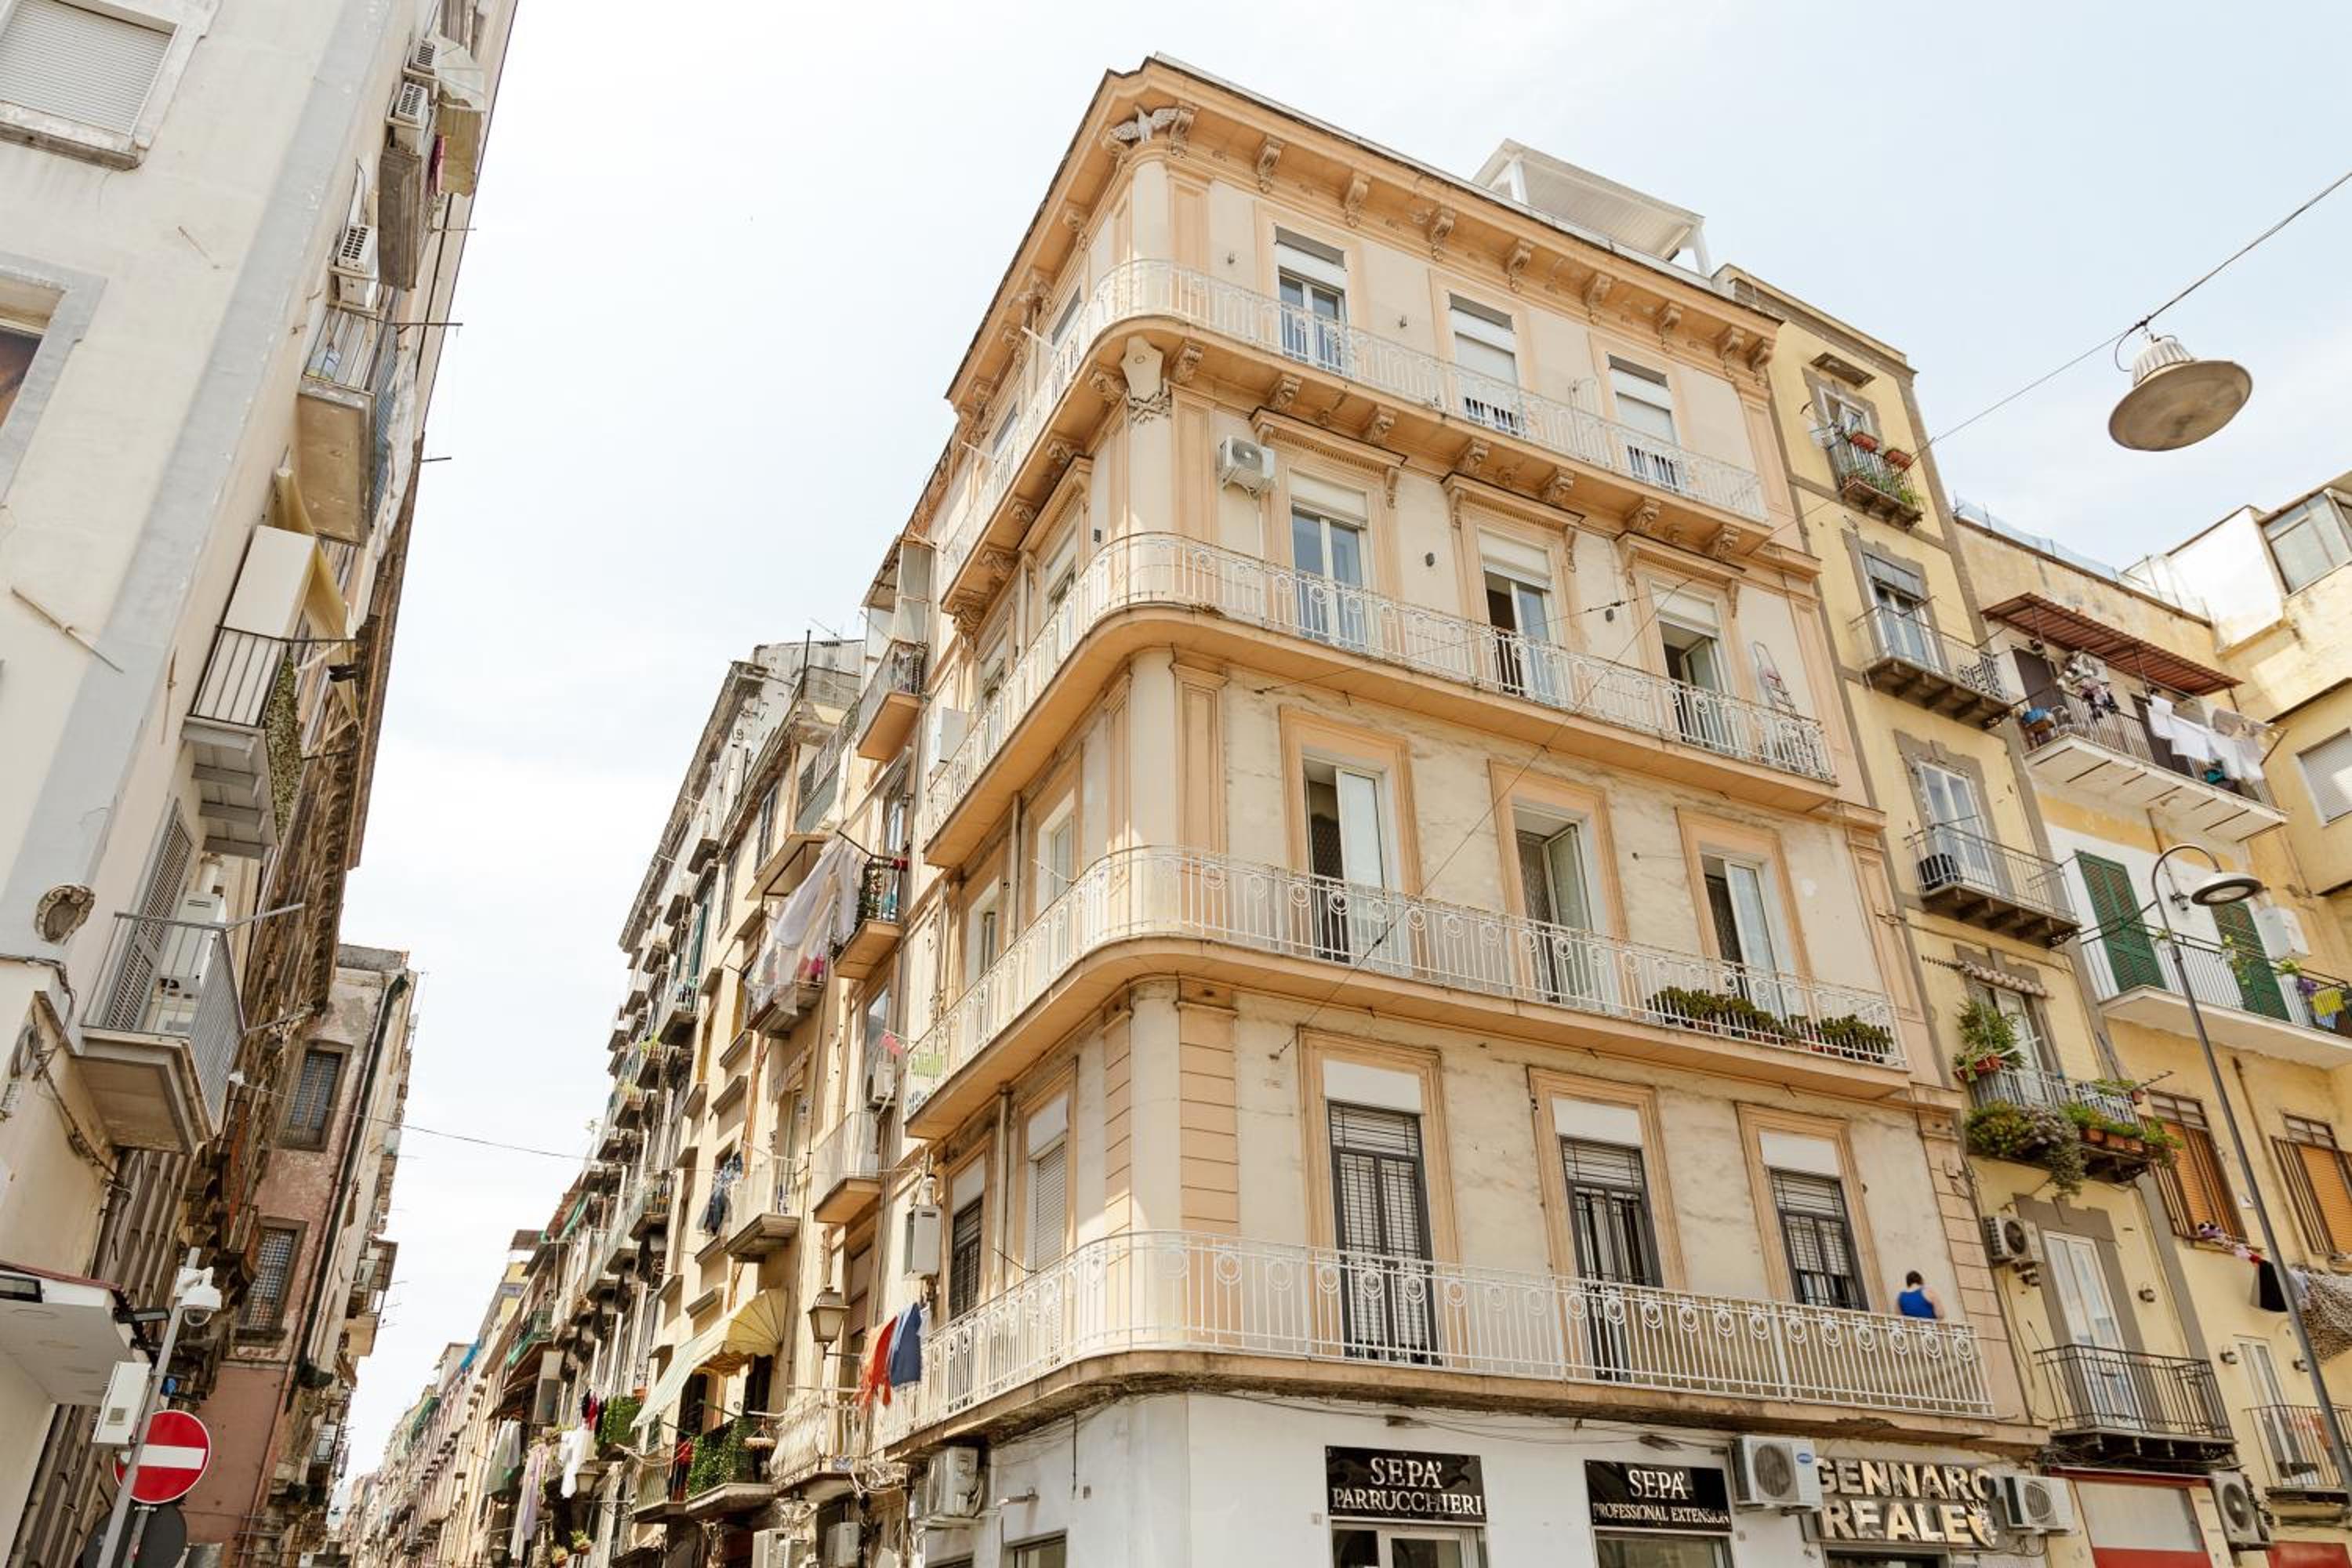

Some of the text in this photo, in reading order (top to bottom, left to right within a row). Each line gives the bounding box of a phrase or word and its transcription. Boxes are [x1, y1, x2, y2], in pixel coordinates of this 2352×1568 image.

[1816, 1457, 1997, 1501] GENNARO
[1333, 1488, 1483, 1515] PARRUCCHIERI
[1592, 1502, 1668, 1522] PROFESSIONAL
[1820, 1499, 1973, 1543] REALE
